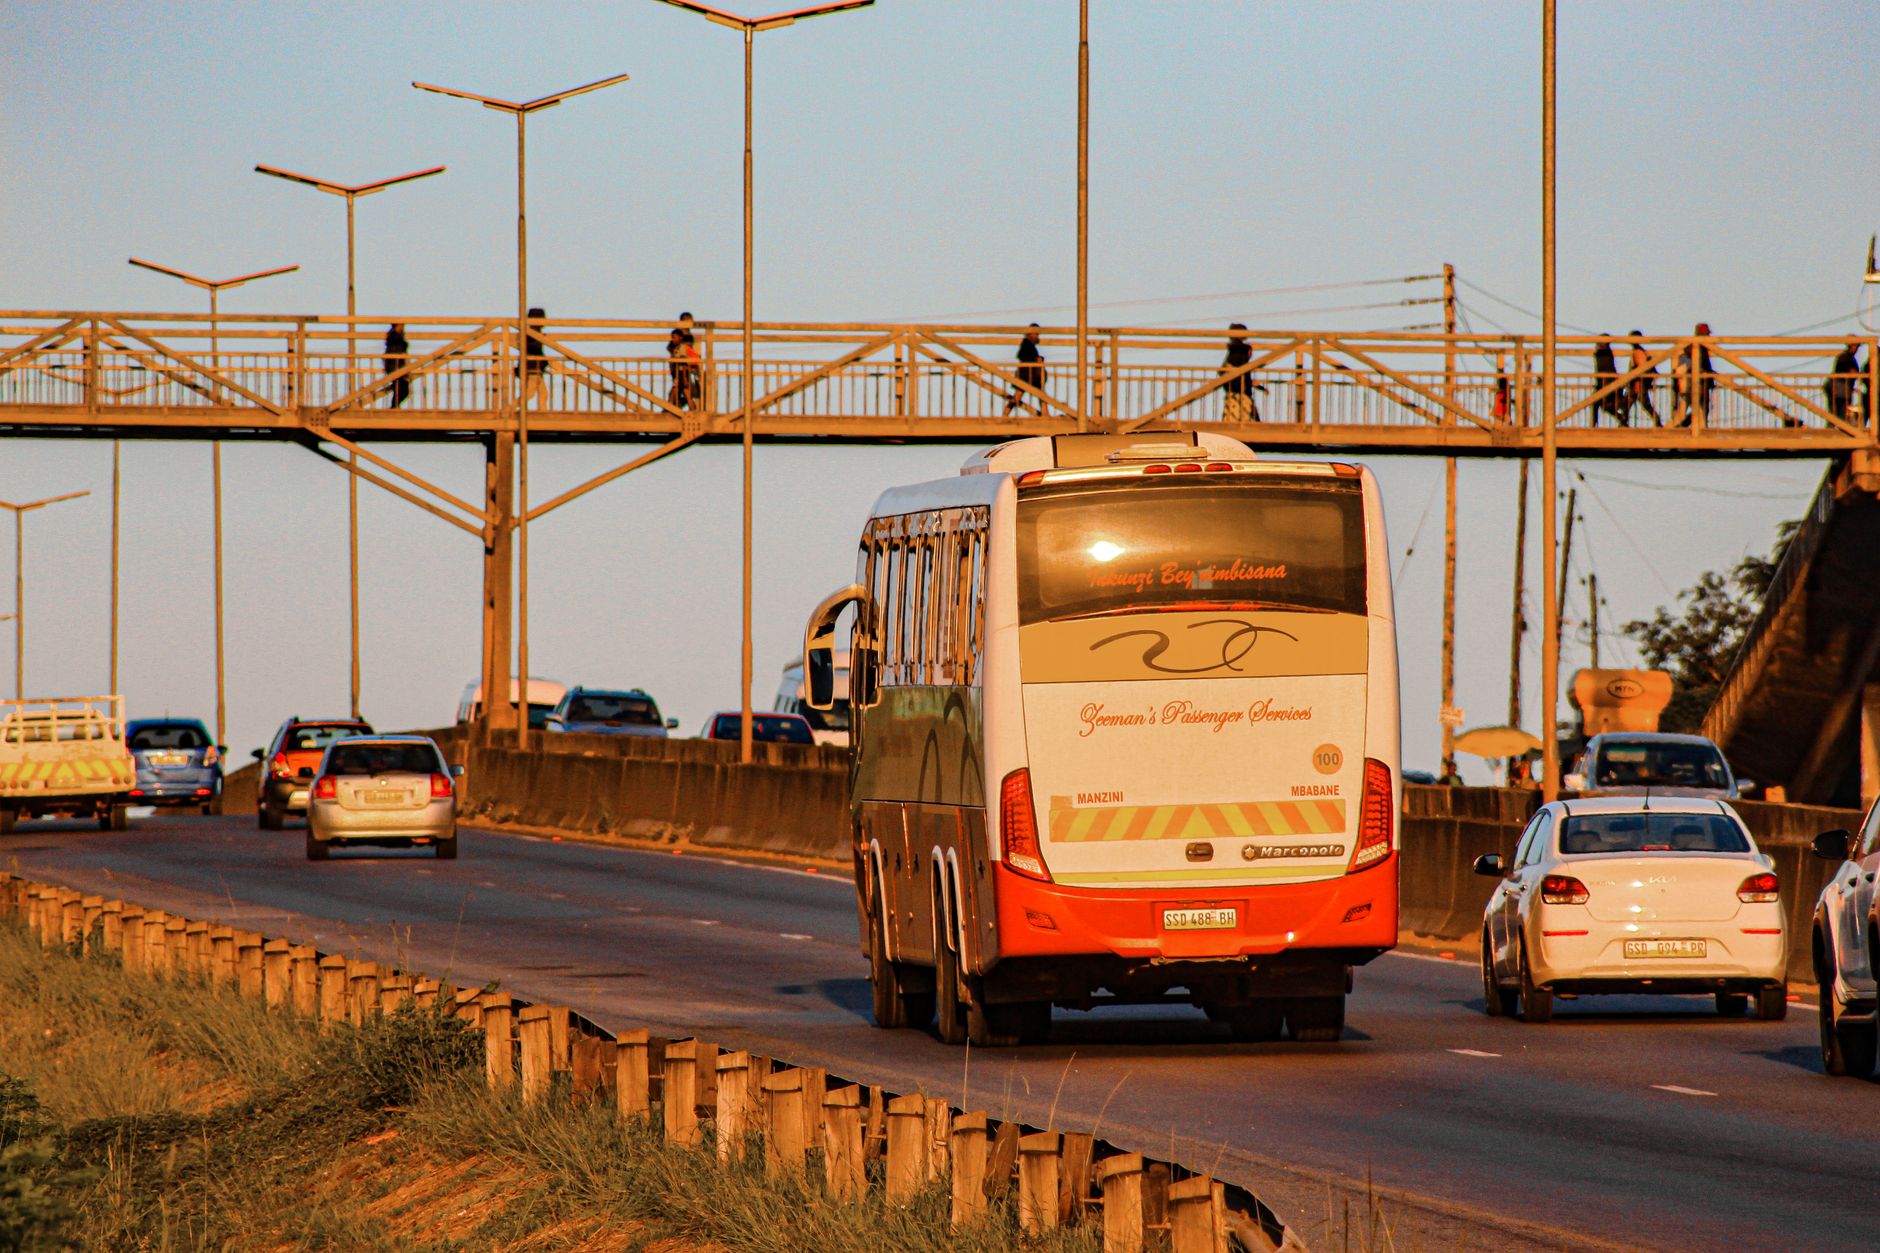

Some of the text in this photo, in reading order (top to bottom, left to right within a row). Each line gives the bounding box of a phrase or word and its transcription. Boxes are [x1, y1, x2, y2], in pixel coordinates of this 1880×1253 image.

[1079, 698, 1312, 737] Zeeman's Passenger Services
[1317, 752, 1340, 766] 100
[1291, 784, 1340, 797] MBABANE
[1077, 791, 1124, 804] MANZINI
[1260, 844, 1344, 857] Marcopolo
[1165, 913, 1187, 926] SSD
[1190, 912, 1211, 926] 488
[1219, 911, 1234, 925] BH
[1690, 942, 1705, 955] PR
